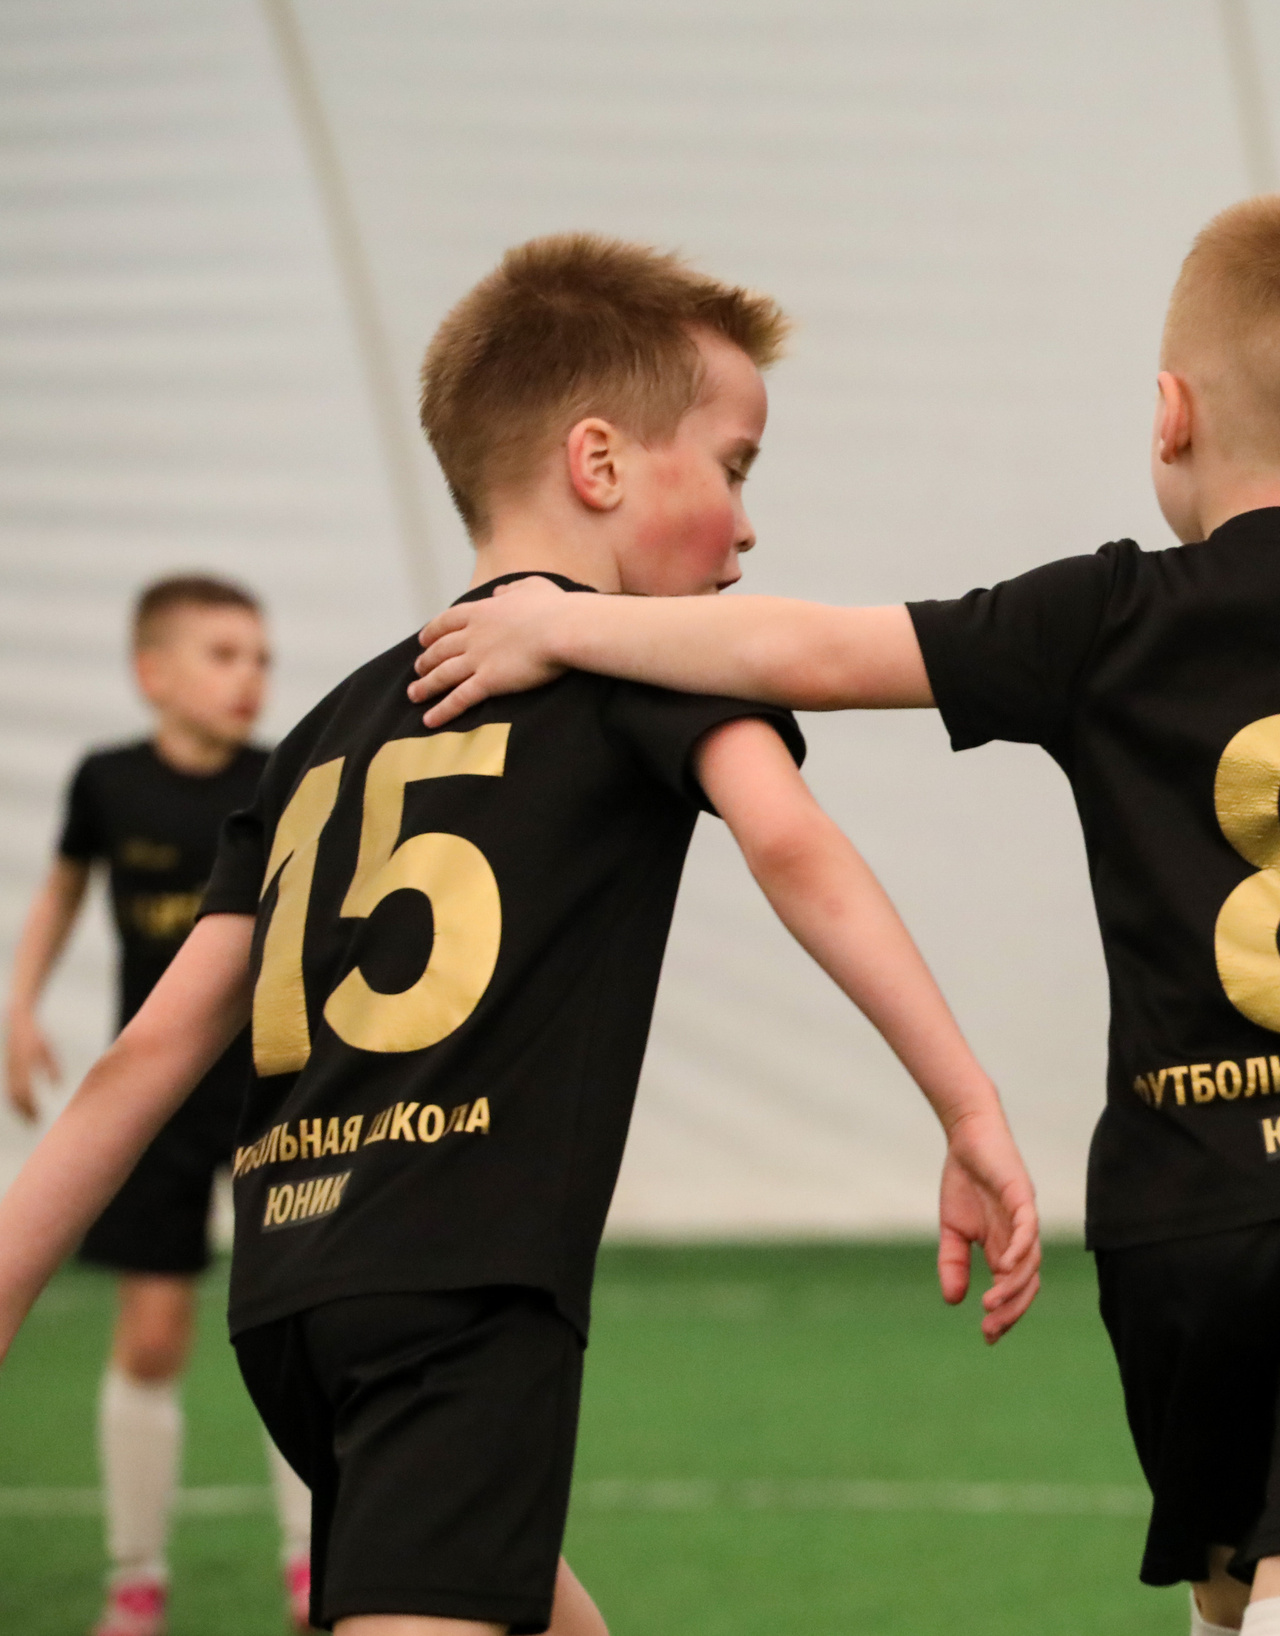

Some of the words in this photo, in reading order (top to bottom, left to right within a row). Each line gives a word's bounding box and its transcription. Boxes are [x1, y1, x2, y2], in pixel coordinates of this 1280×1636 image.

[251, 722, 512, 1078] 15
[363, 1097, 490, 1146] ШКОЛА
[263, 1170, 352, 1227] ЮНИК
